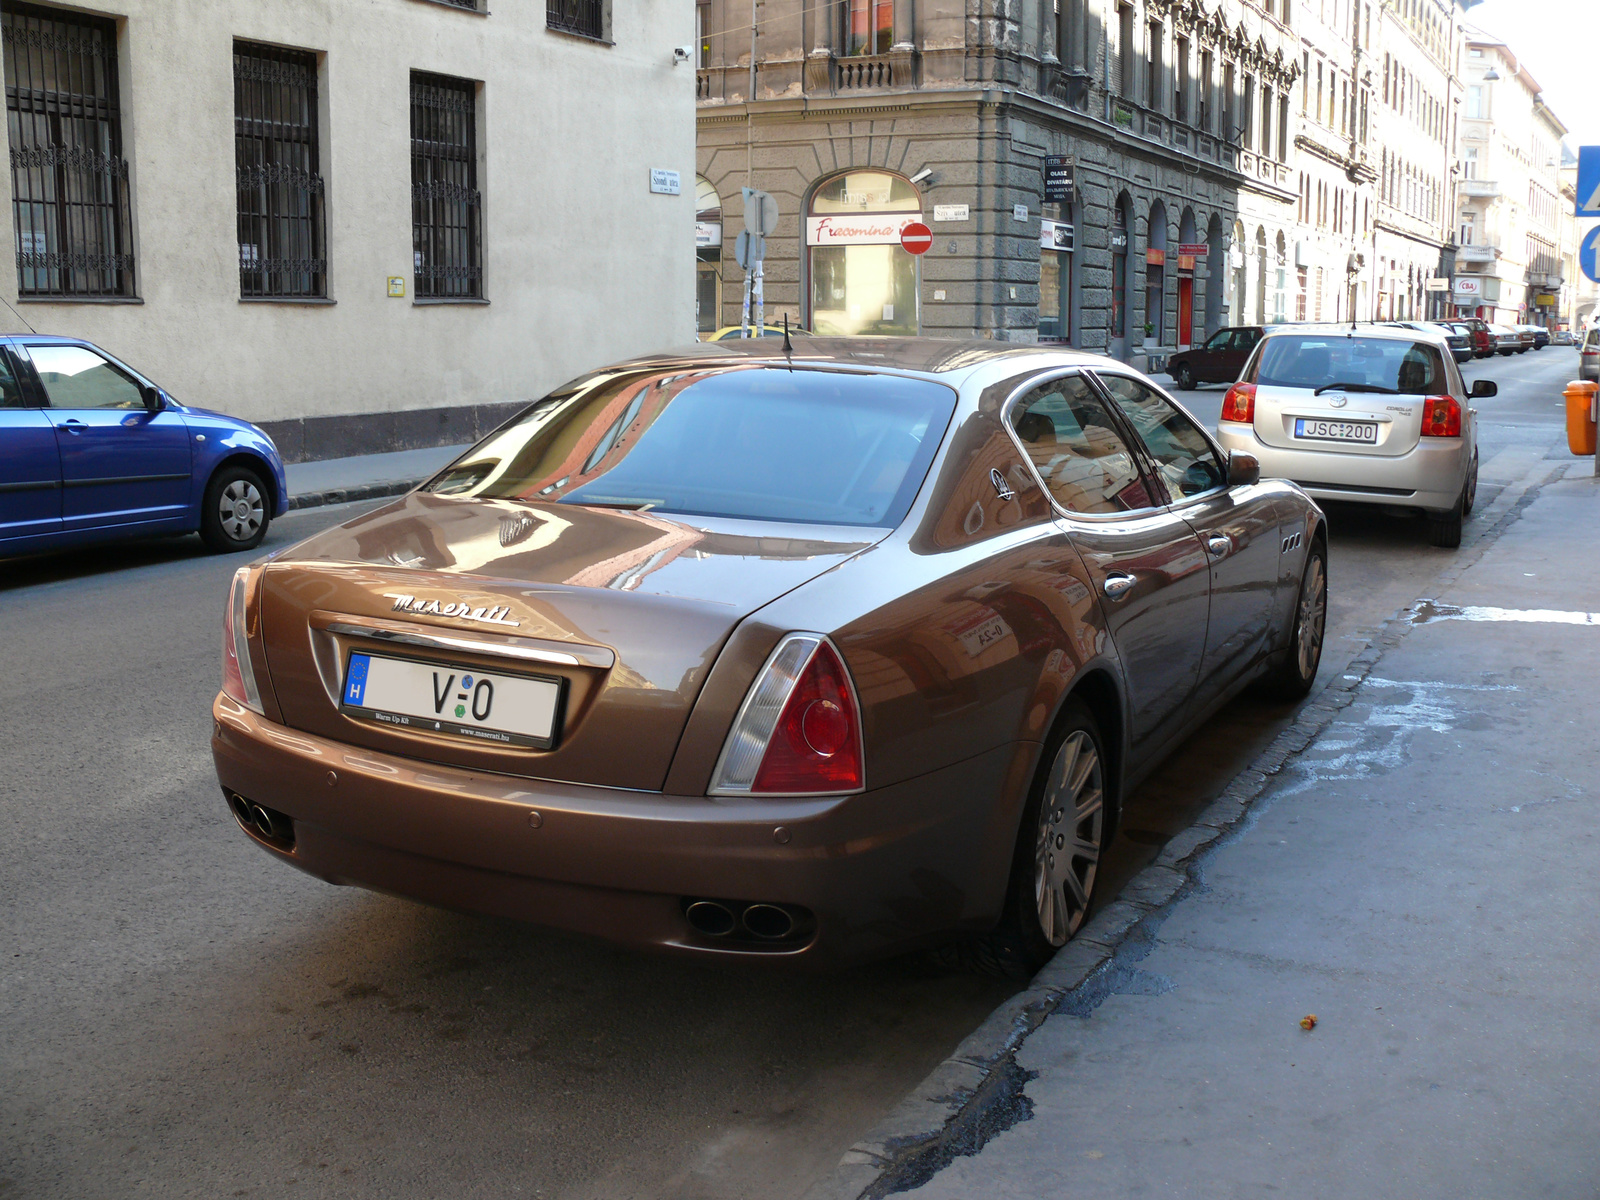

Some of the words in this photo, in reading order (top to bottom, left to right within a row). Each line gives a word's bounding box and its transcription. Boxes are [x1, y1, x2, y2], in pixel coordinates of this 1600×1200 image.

[815, 217, 894, 243] Fracomina
[1462, 282, 1474, 290] CBA
[382, 593, 521, 626] Maserati
[349, 684, 360, 699] H
[375, 712, 391, 722] Warm
[391, 715, 400, 724] Up
[400, 716, 410, 725] Kft
[460, 727, 510, 742] www.maserati.hu
